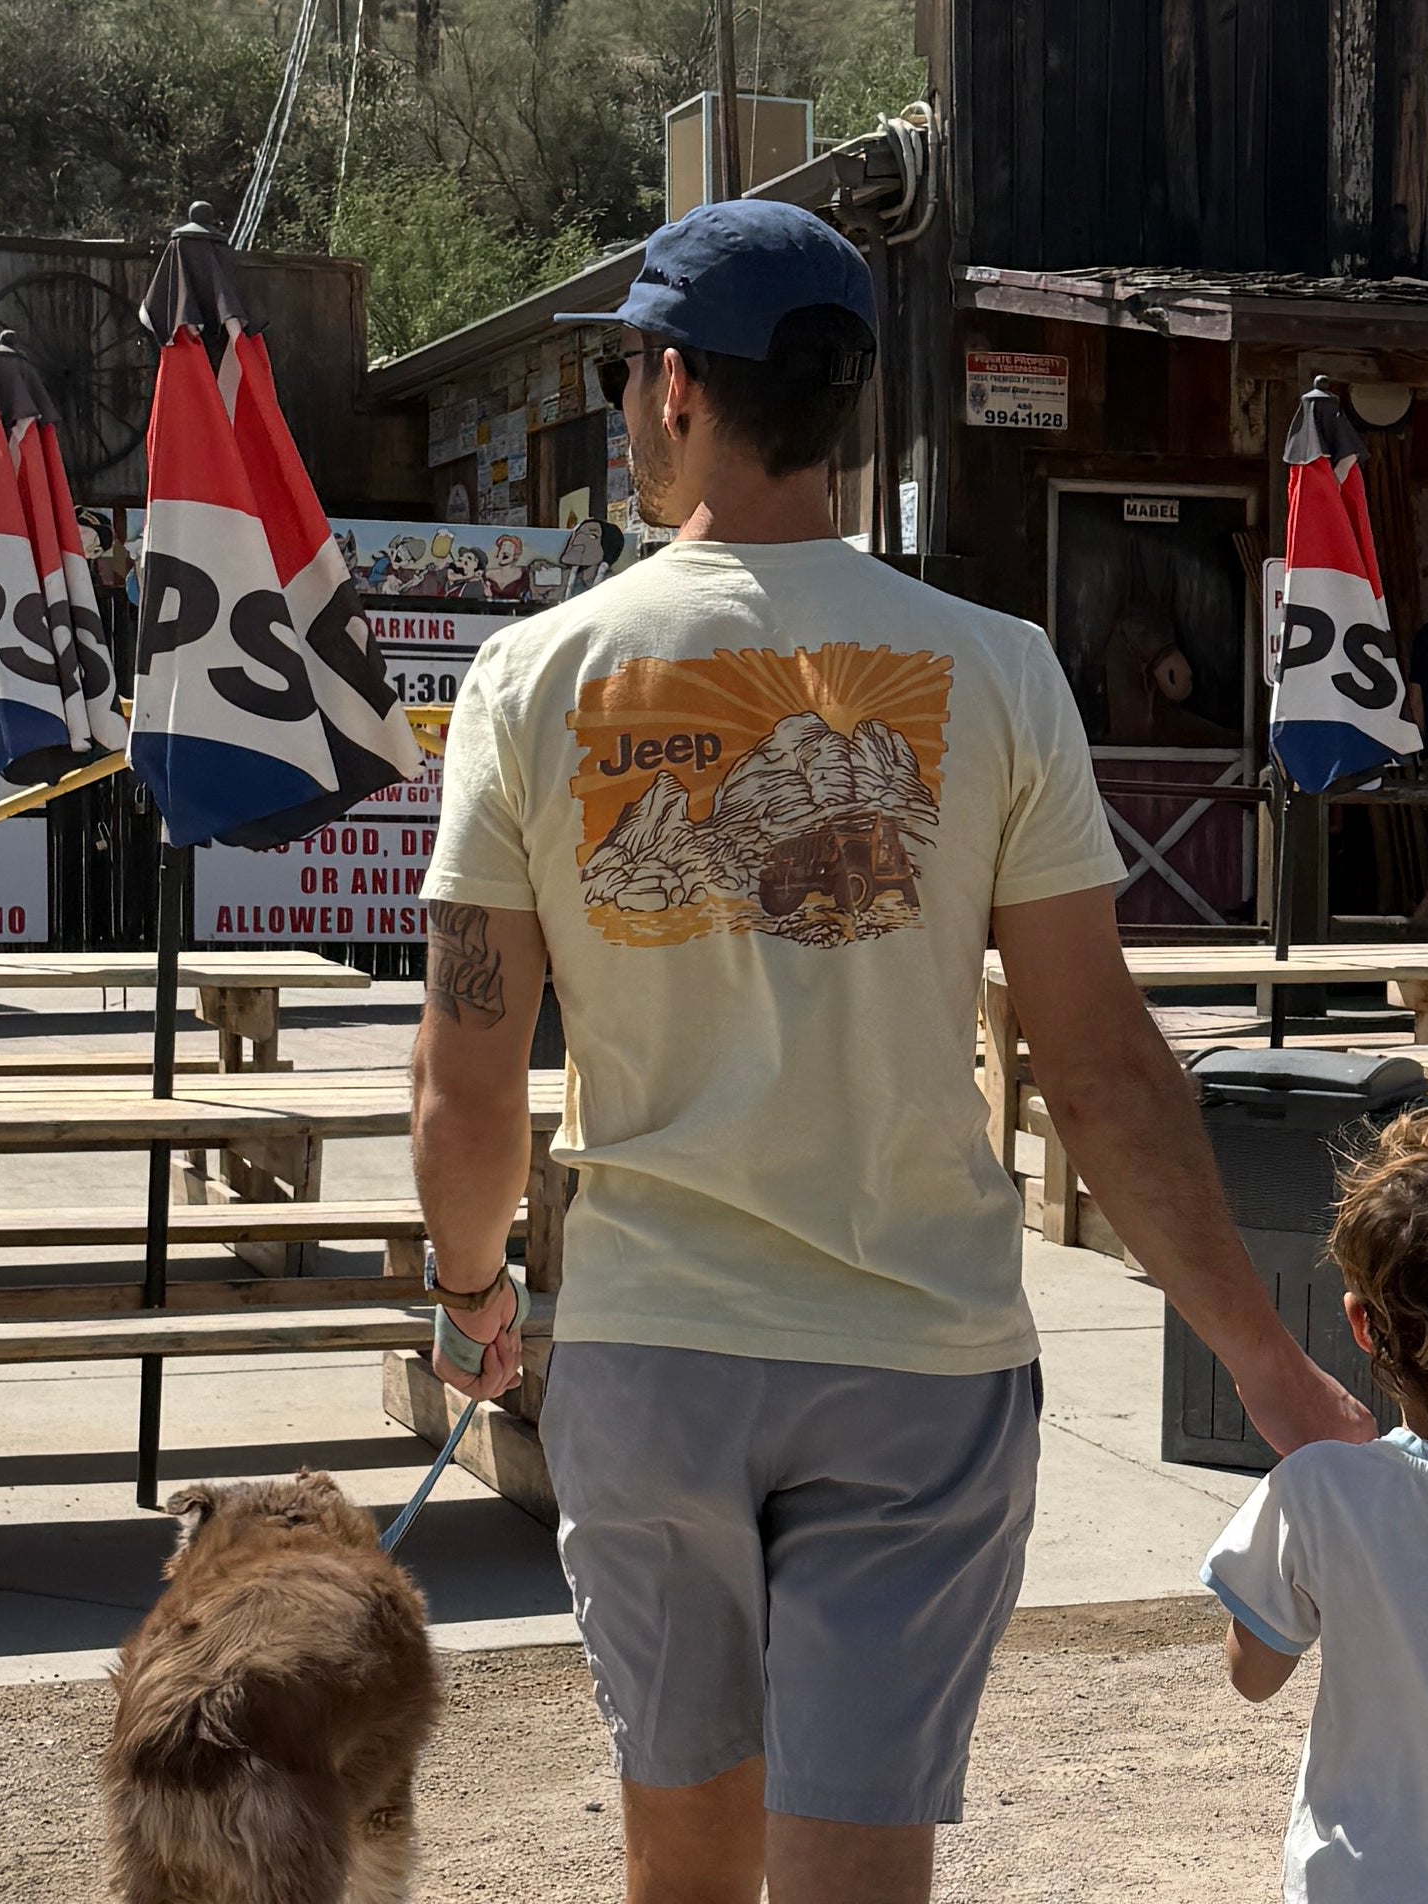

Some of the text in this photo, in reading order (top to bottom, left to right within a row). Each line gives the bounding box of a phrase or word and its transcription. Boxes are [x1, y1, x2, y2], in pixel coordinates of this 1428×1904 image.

[984, 410, 1063, 427] 994-1128
[1126, 503, 1177, 518] MABEL
[368, 617, 456, 641] ARKING
[597, 733, 722, 776] Jeep
[301, 867, 424, 896] OR ANIM
[216, 906, 354, 934] ALLOWED
[367, 907, 428, 935] INSI
